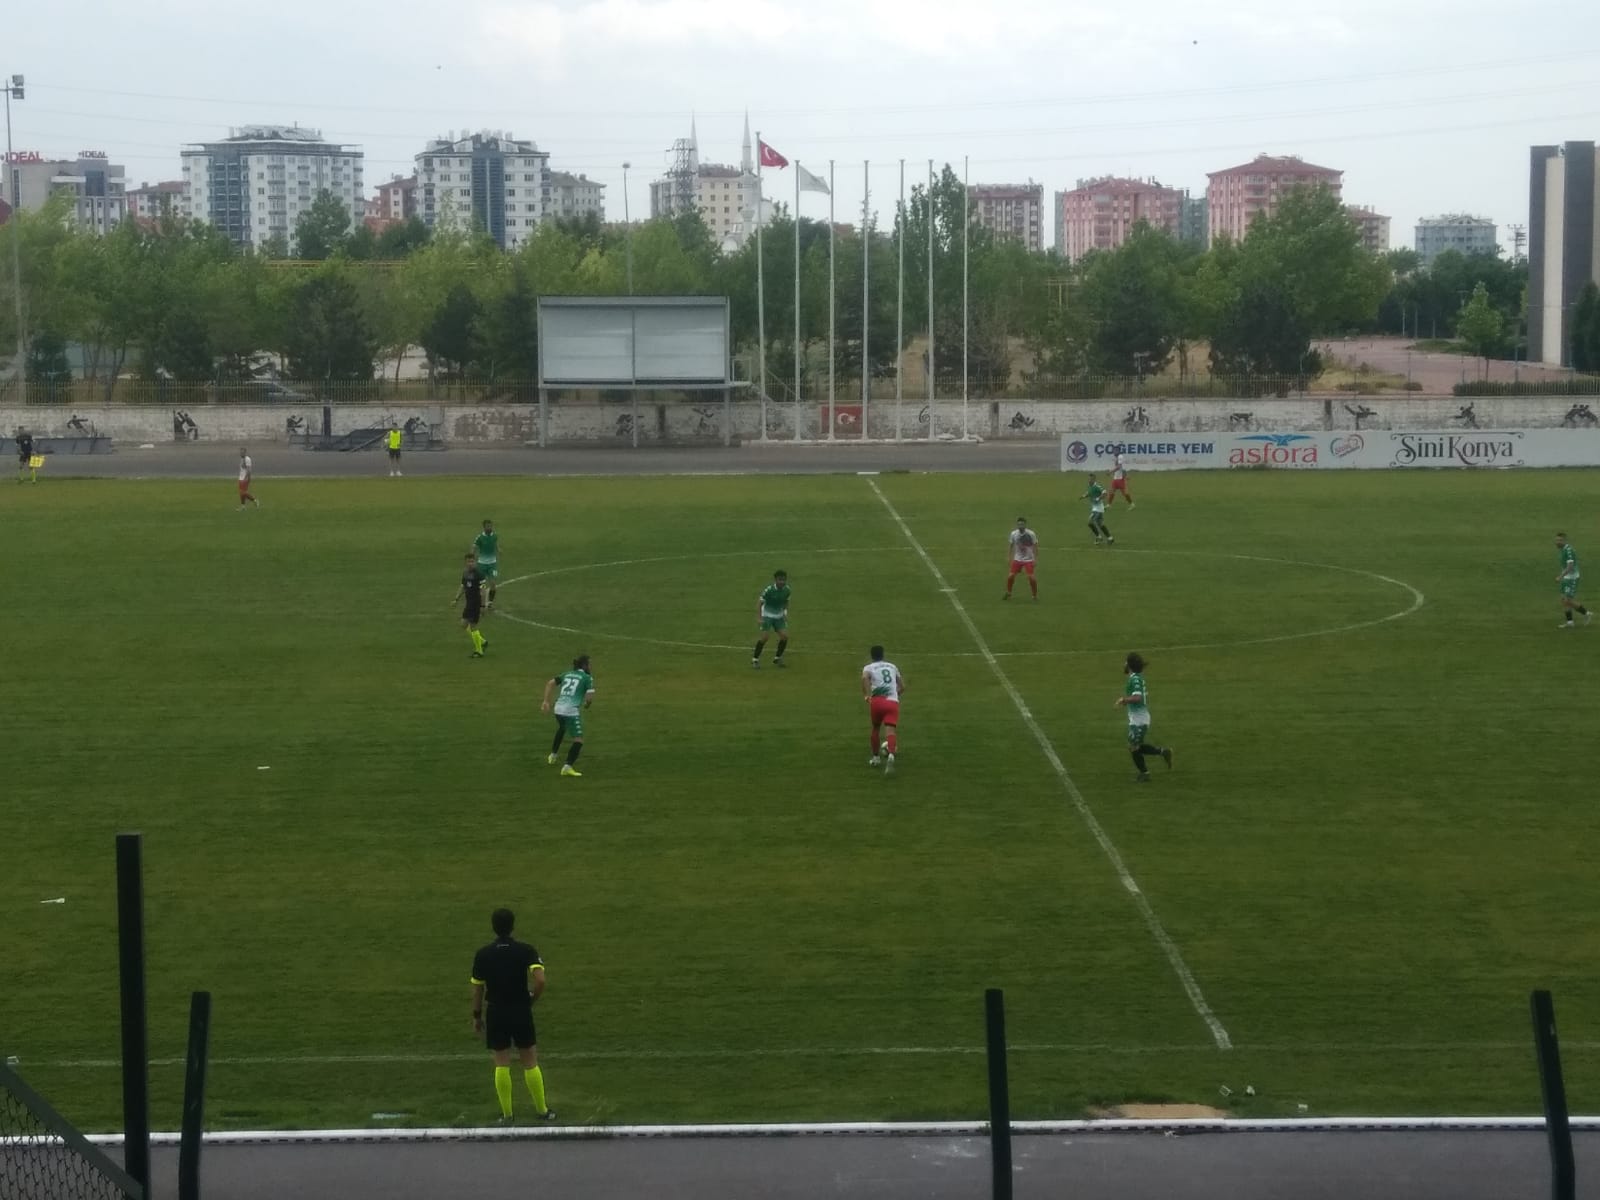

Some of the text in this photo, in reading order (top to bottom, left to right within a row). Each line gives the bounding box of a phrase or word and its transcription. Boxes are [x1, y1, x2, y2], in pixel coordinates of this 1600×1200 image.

[1181, 443, 1214, 454] YEM
[1229, 442, 1317, 464] asfora
[881, 669, 892, 684] 8
